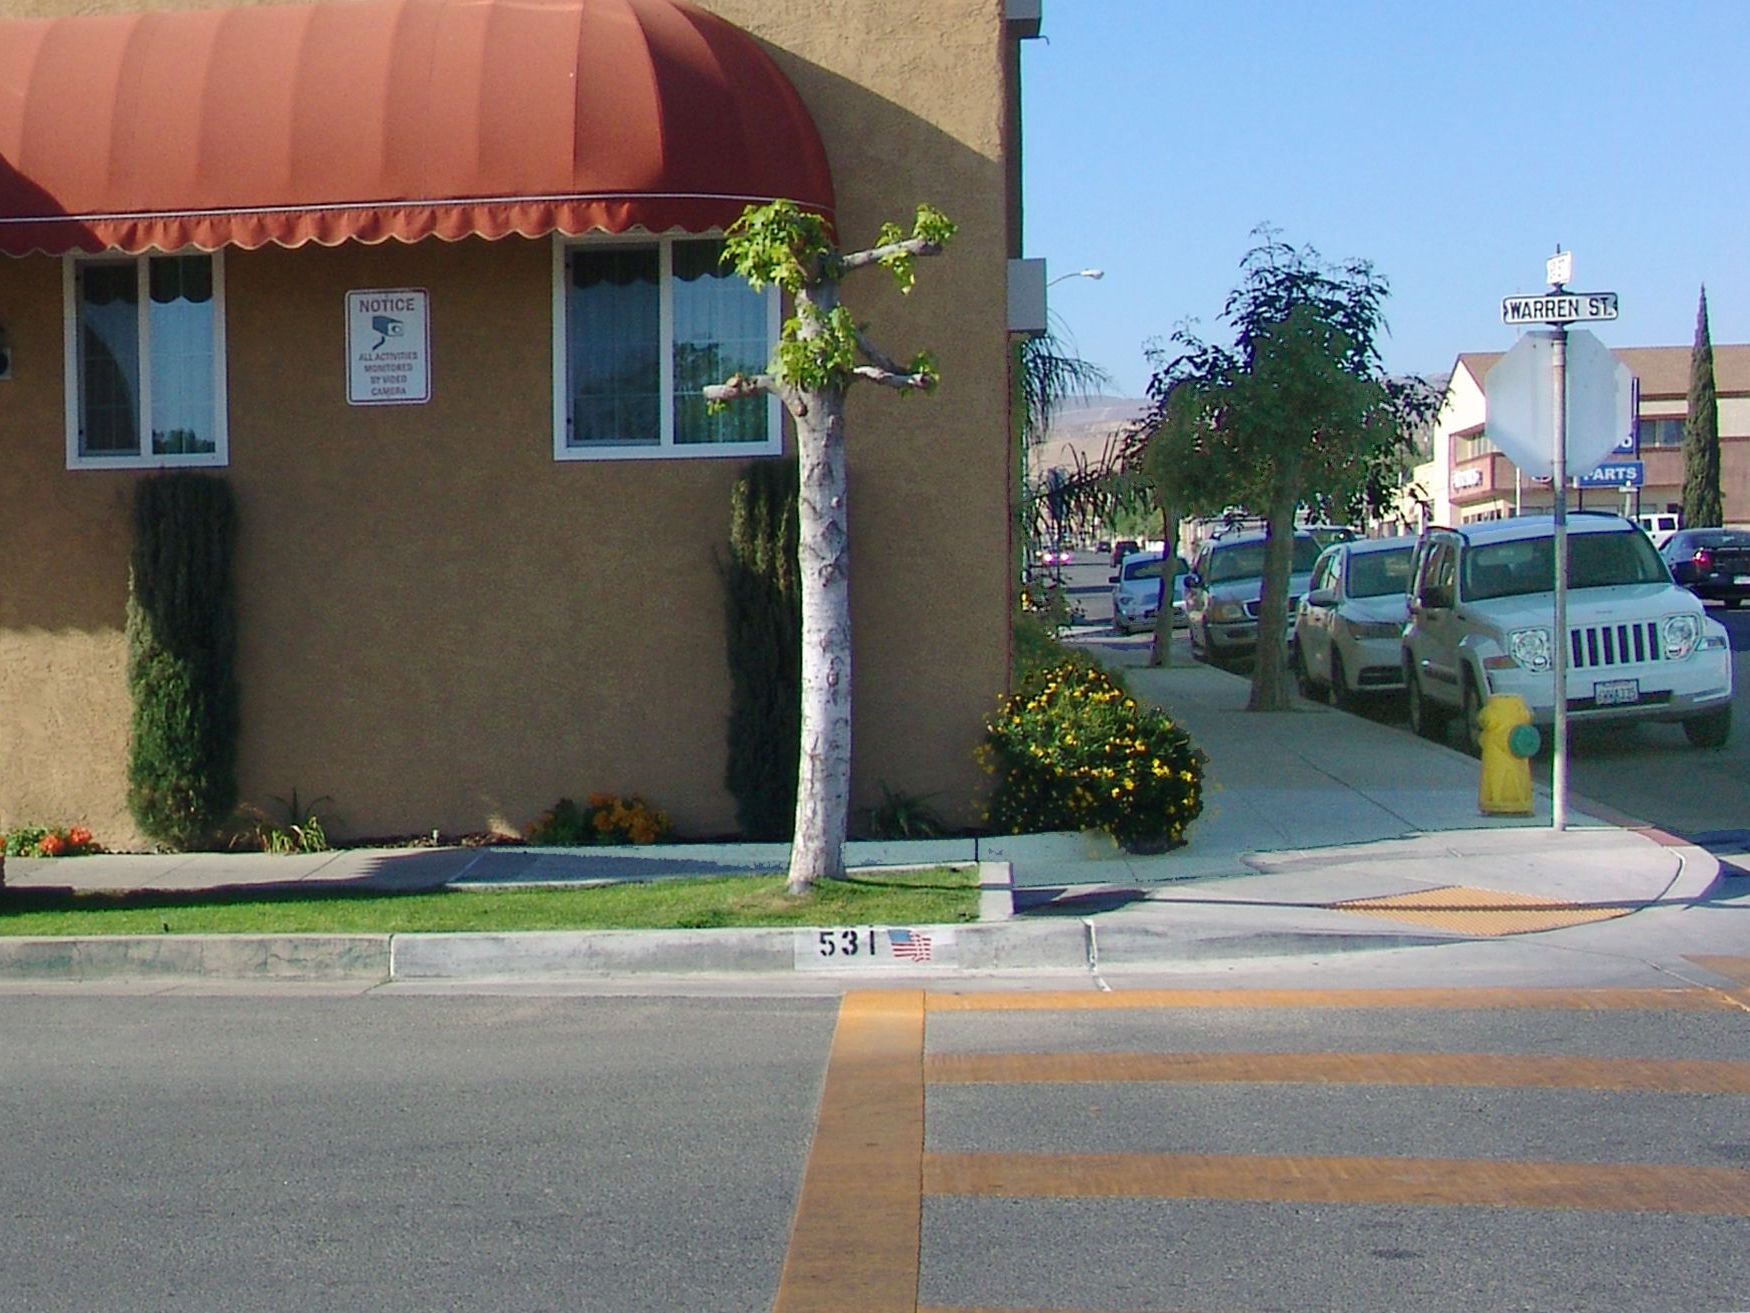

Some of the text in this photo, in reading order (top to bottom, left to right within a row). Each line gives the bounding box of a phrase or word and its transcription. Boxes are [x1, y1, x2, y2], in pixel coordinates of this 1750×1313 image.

[359, 298, 415, 313] NOTICE
[1510, 299, 1579, 319] WARREN
[359, 351, 418, 361] ALL ACTIVITIES
[371, 387, 406, 396] CAMERA
[820, 930, 875, 956] 531
